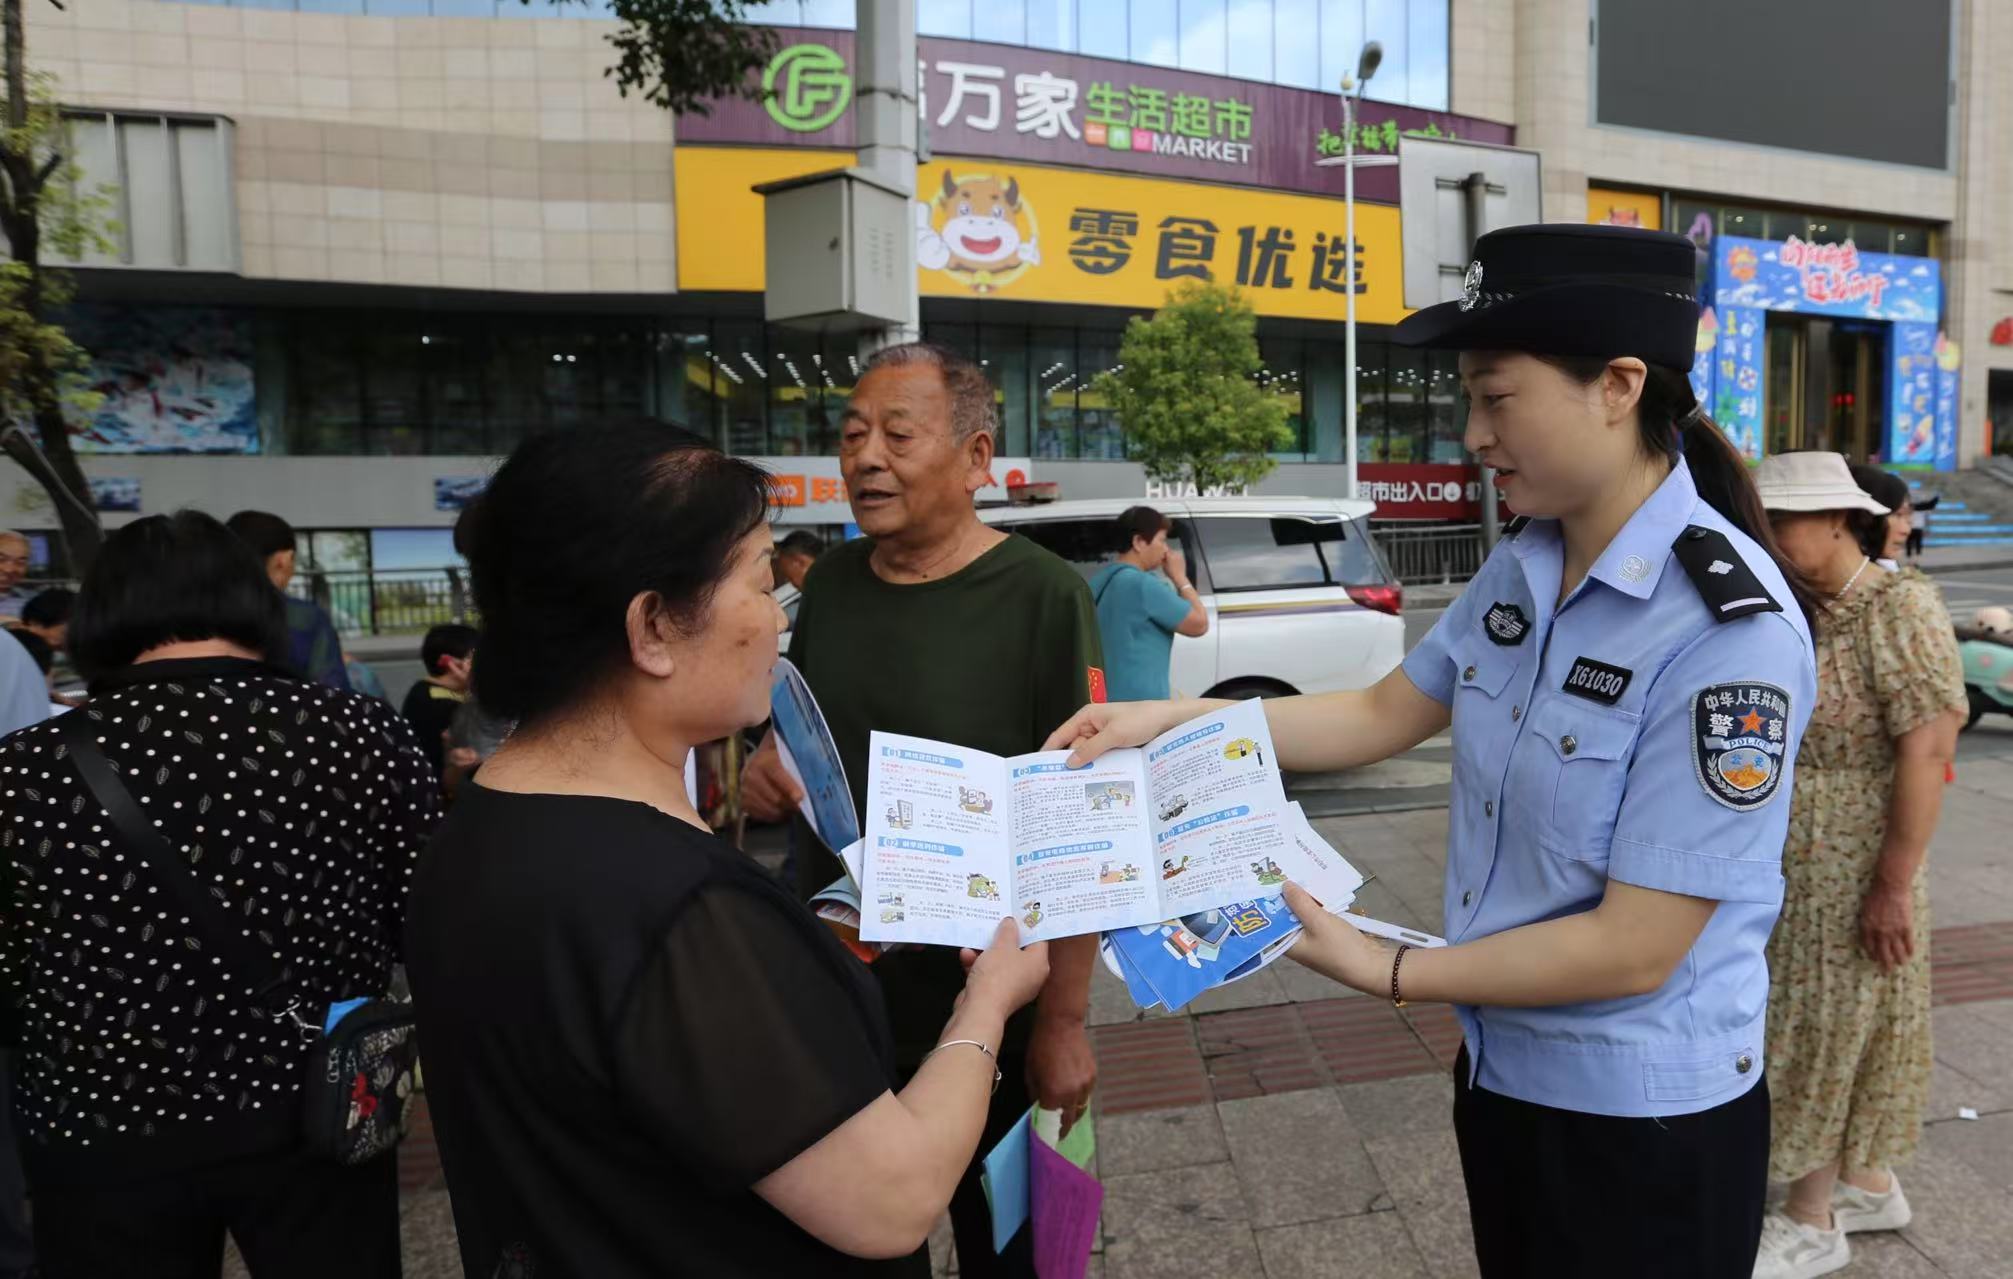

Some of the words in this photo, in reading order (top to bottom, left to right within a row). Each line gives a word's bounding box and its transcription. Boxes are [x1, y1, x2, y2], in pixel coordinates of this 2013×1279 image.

[918, 58, 1082, 140] 万家
[1085, 81, 1253, 140] 生活超市
[1152, 133, 1253, 164] MARKET
[1068, 207, 1367, 295] 零食优选
[1145, 480, 1249, 499] HUAWI
[1569, 665, 1624, 696] X61030
[1704, 688, 1787, 719] 中华人民共和国
[1728, 738, 1770, 753] POLICE
